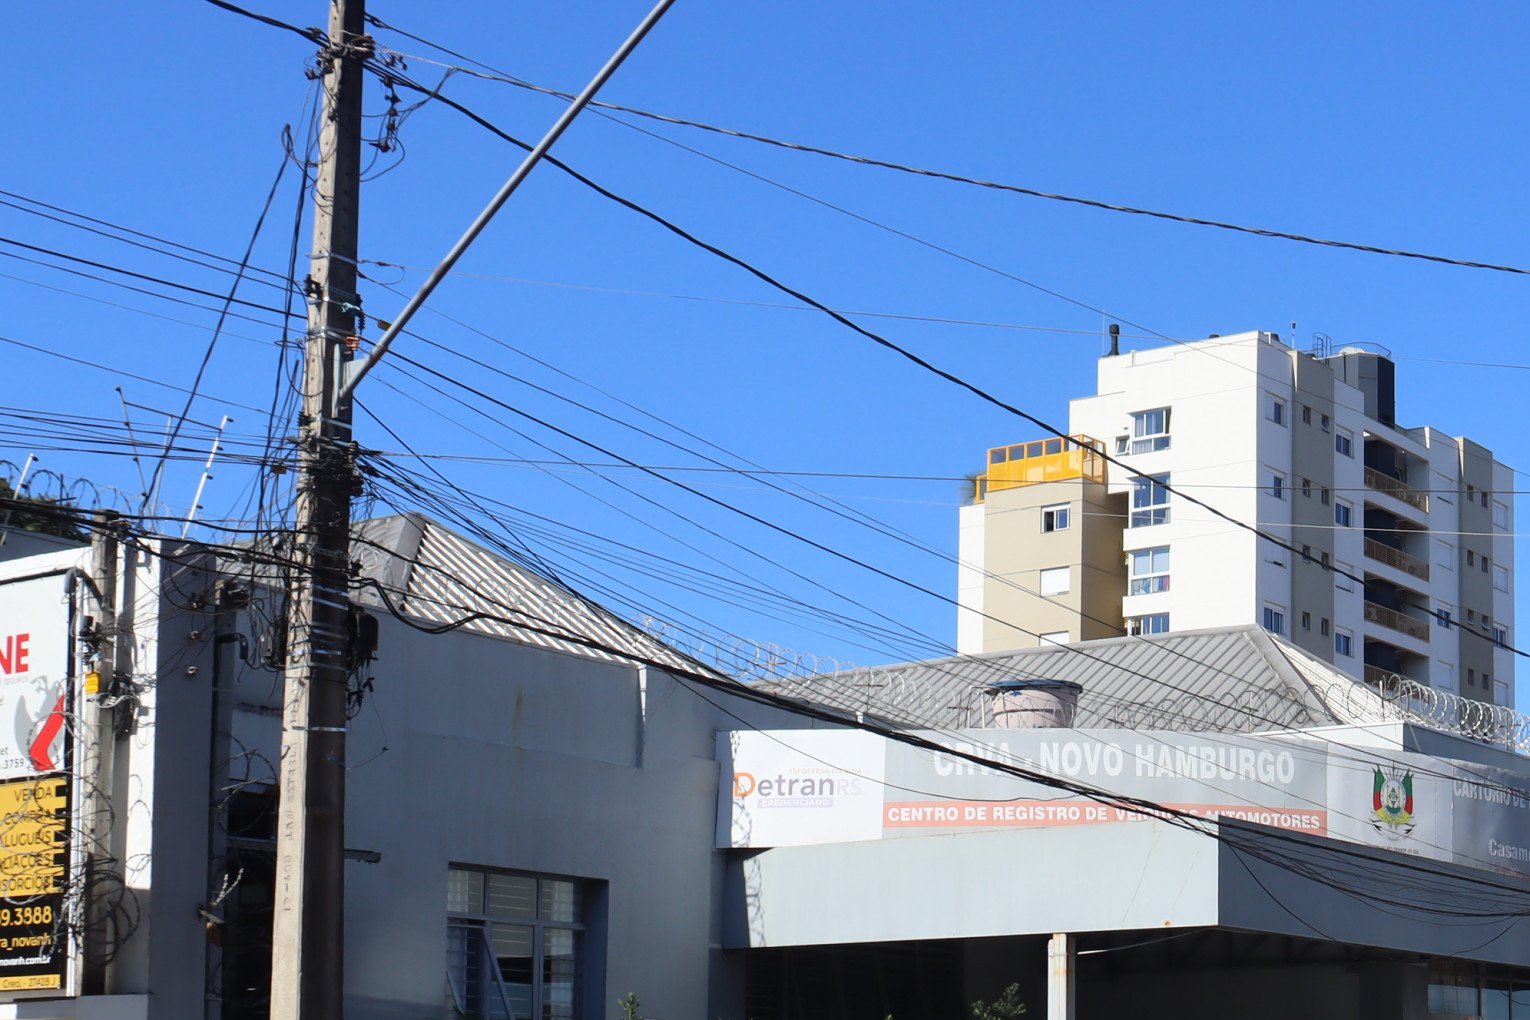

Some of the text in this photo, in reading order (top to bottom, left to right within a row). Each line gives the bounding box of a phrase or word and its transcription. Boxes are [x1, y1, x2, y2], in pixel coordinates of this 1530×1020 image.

[934, 742, 1013, 776] CRVA
[1040, 742, 1123, 777] NOVO
[1136, 743, 1295, 785] HAMBURGO
[14, 787, 52, 802] VENDA
[1453, 776, 1511, 806] CARTÓRIO
[761, 799, 830, 807] CREDENCIADO
[888, 806, 959, 822] CENTRO
[964, 807, 987, 821] DE
[992, 806, 1080, 821] REGISTRO
[1085, 807, 1108, 821] DE
